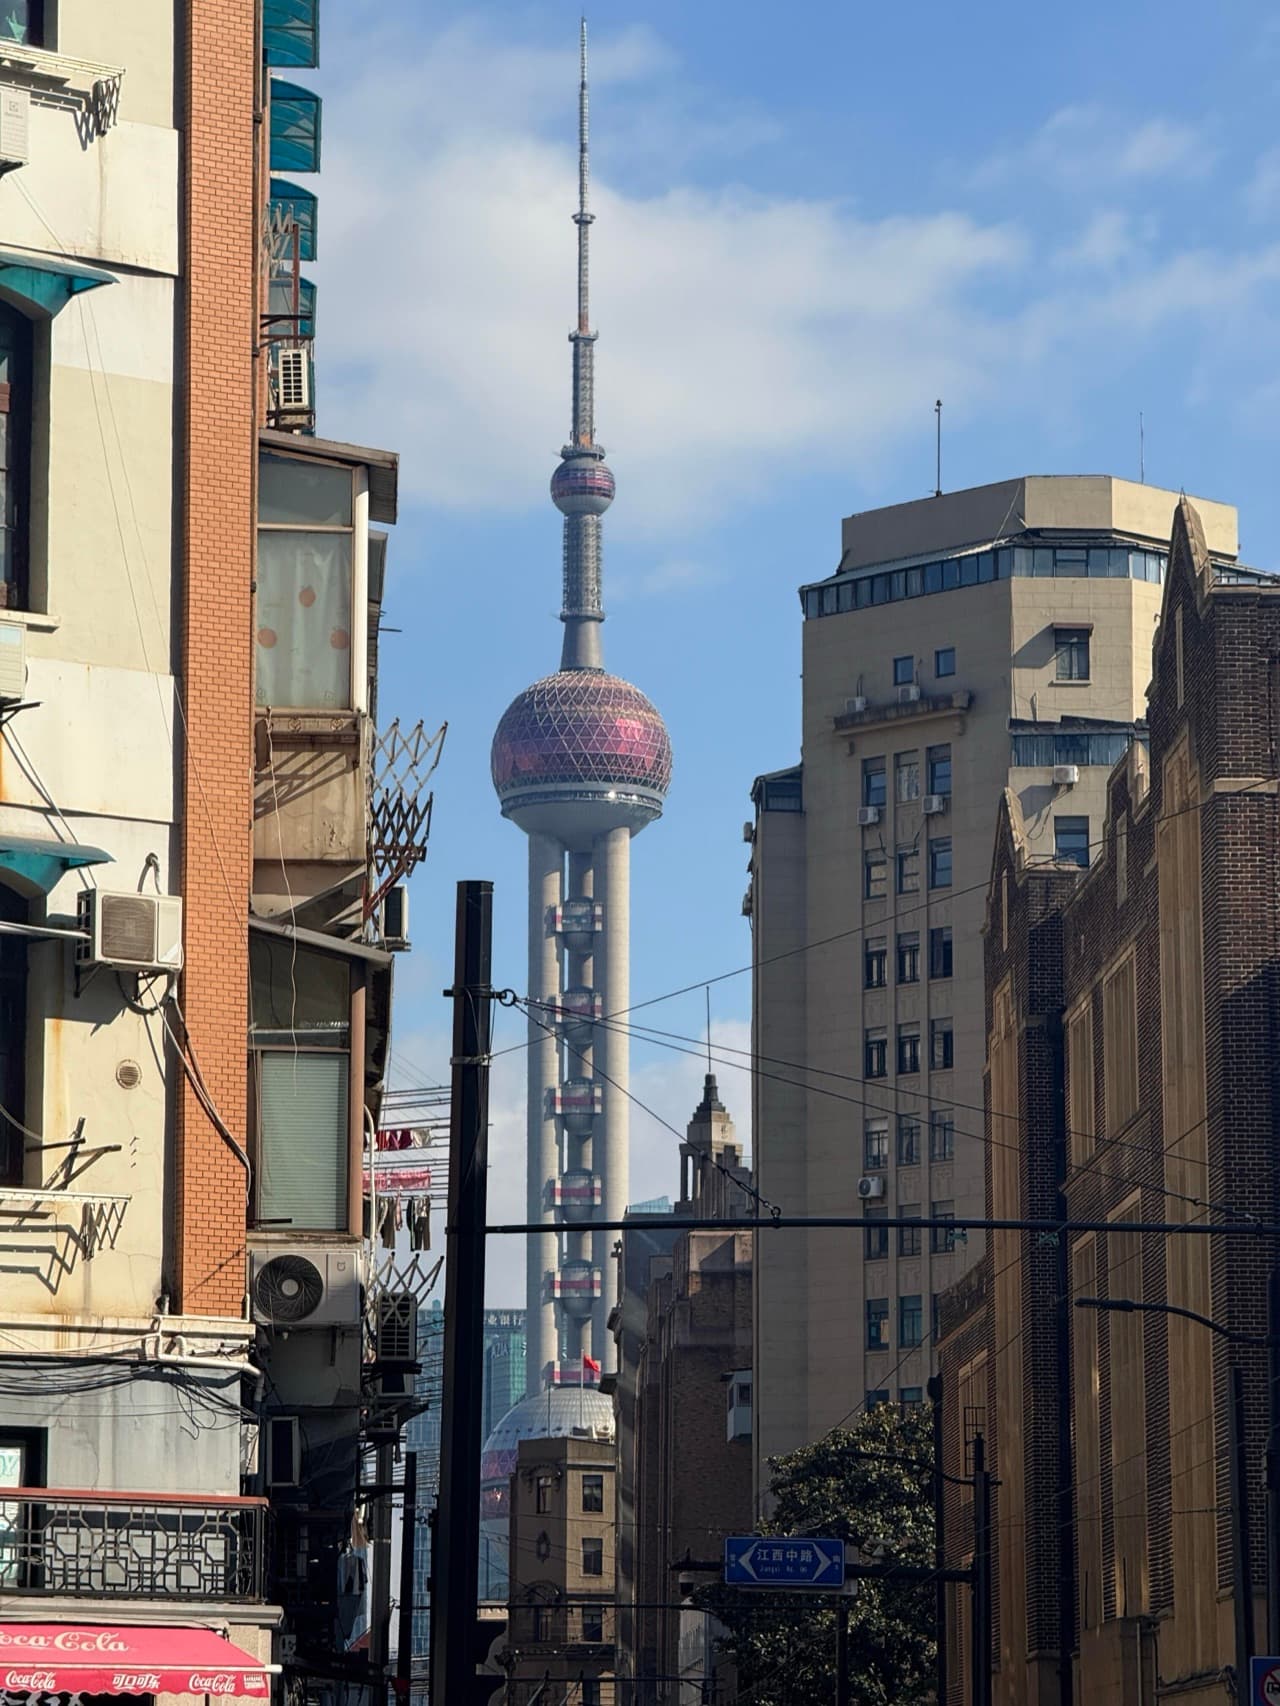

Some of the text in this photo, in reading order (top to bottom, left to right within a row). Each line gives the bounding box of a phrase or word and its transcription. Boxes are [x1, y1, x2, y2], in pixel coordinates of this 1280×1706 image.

[757, 1547, 813, 1563] 江西中路
[0, 1631, 129, 1651] oca-Cola
[5, 1670, 57, 1689] Coca-Cola
[112, 1672, 161, 1690] 可口可乐
[189, 1673, 236, 1693] Coca-Cola
